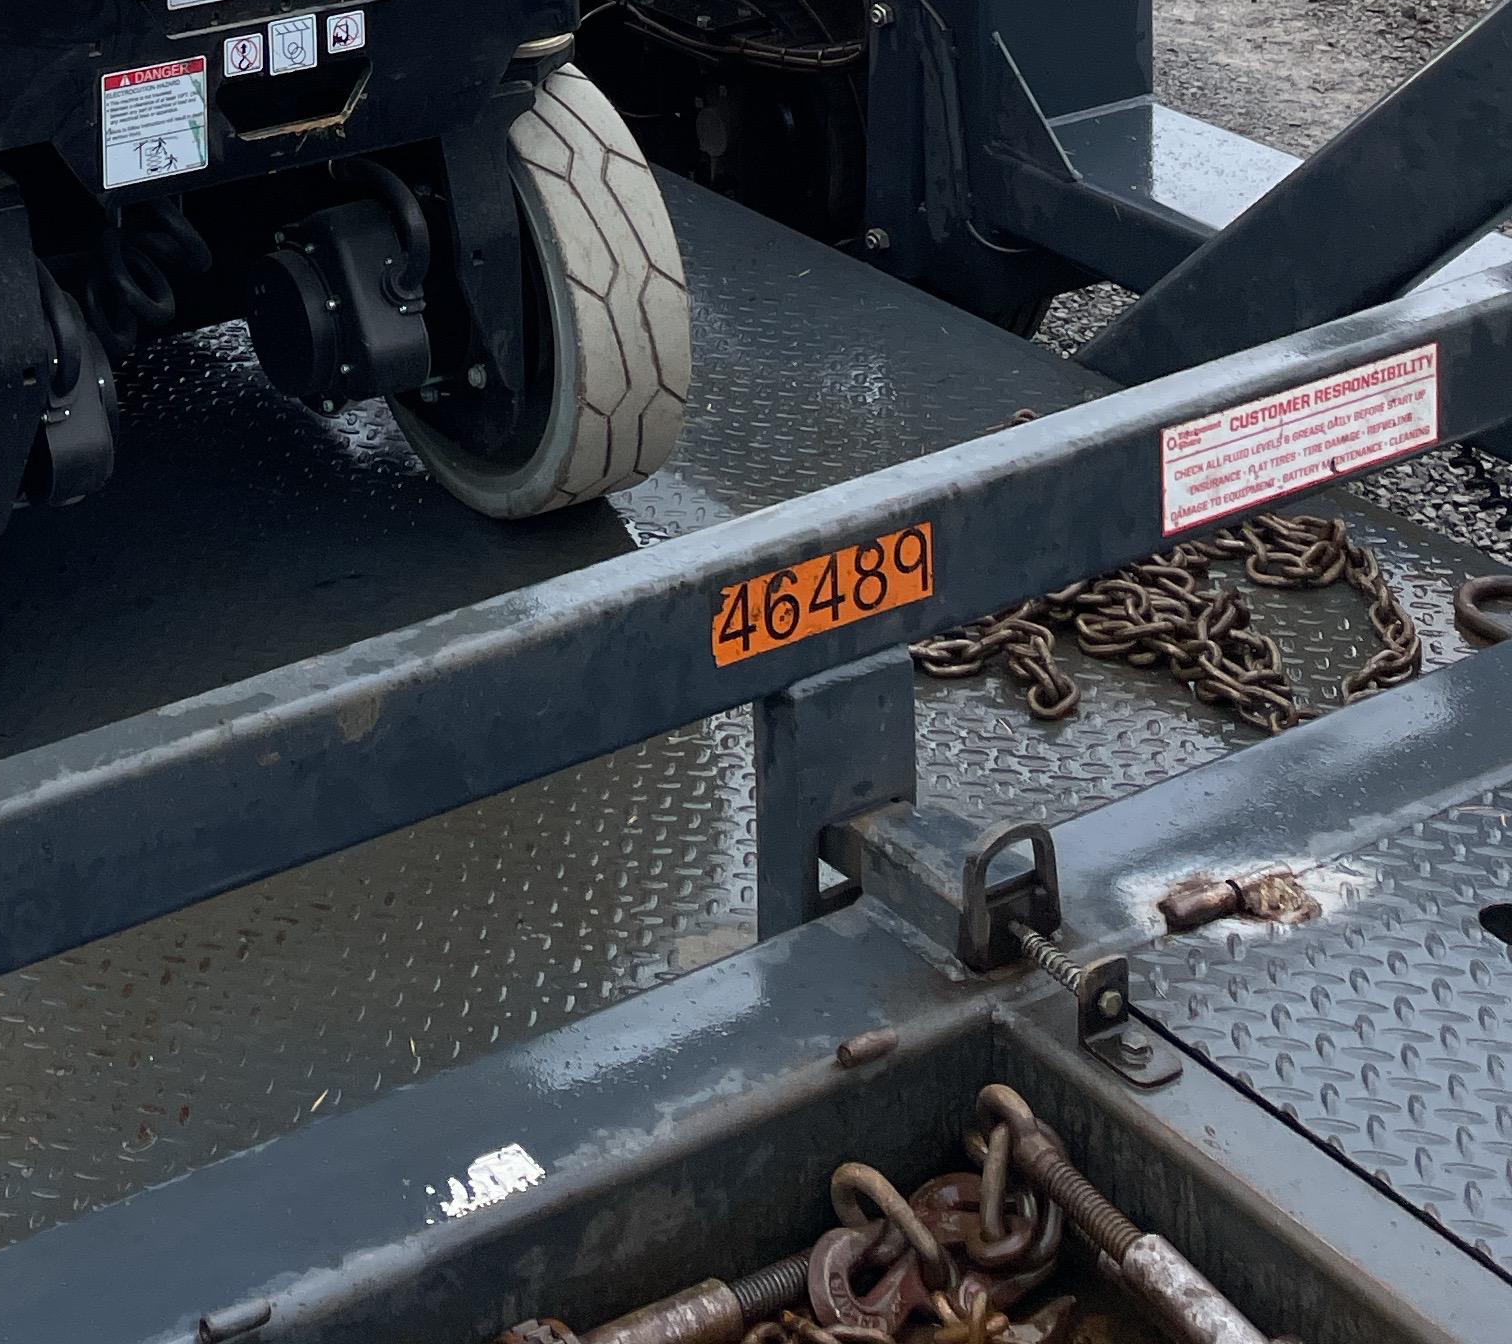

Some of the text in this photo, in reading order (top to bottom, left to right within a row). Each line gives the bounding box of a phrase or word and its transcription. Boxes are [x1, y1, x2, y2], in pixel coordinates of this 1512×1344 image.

[134, 63, 190, 84] DANGER
[1174, 462, 1205, 481] CHECK
[1205, 456, 1222, 475] ALL
[1223, 448, 1250, 466] FLUID
[1251, 438, 1283, 456] LEVELS
[1291, 422, 1326, 444] GREASE
[1327, 415, 1351, 431] DAILY
[1353, 401, 1385, 423] BEFORE
[1386, 395, 1414, 411] START
[1414, 389, 1427, 401] UP
[1229, 353, 1434, 432] CUSTOMER RESPONSIBILITY
[1170, 425, 1431, 523] DAMAGE TO EQUIPMENT BATTERY MINTENANCE CLEANING
[1189, 468, 1242, 496] INSURANCE
[1270, 451, 1297, 469] TIRES
[1302, 442, 1324, 458] TIRE
[1324, 429, 1361, 450] DAMAGE
[1366, 411, 1414, 436] REFUELING
[718, 528, 928, 651] 46489
